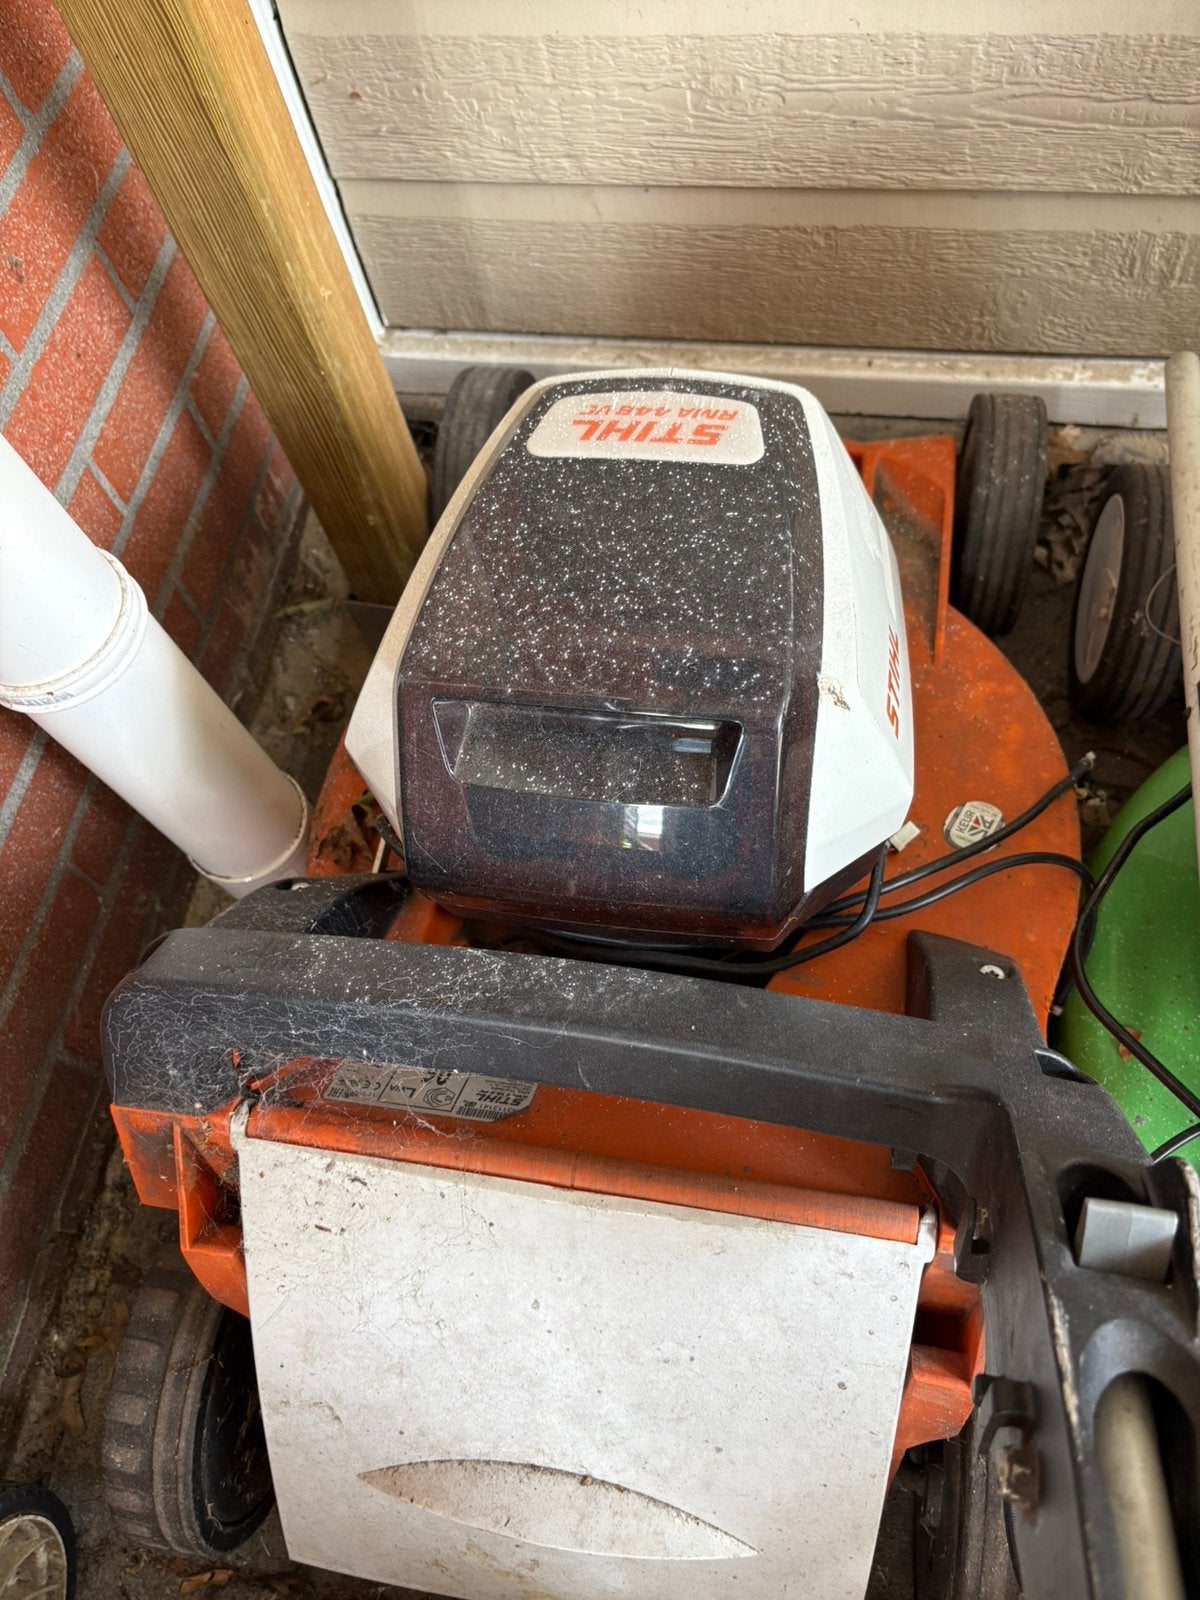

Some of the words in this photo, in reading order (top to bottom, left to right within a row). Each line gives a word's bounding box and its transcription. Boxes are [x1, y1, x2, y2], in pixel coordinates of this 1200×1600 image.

[614, 404, 672, 418] 448
[677, 406, 739, 421] RMA
[572, 419, 729, 446] STIHL
[886, 623, 900, 740] STIHL
[476, 1093, 524, 1107] STIHL
